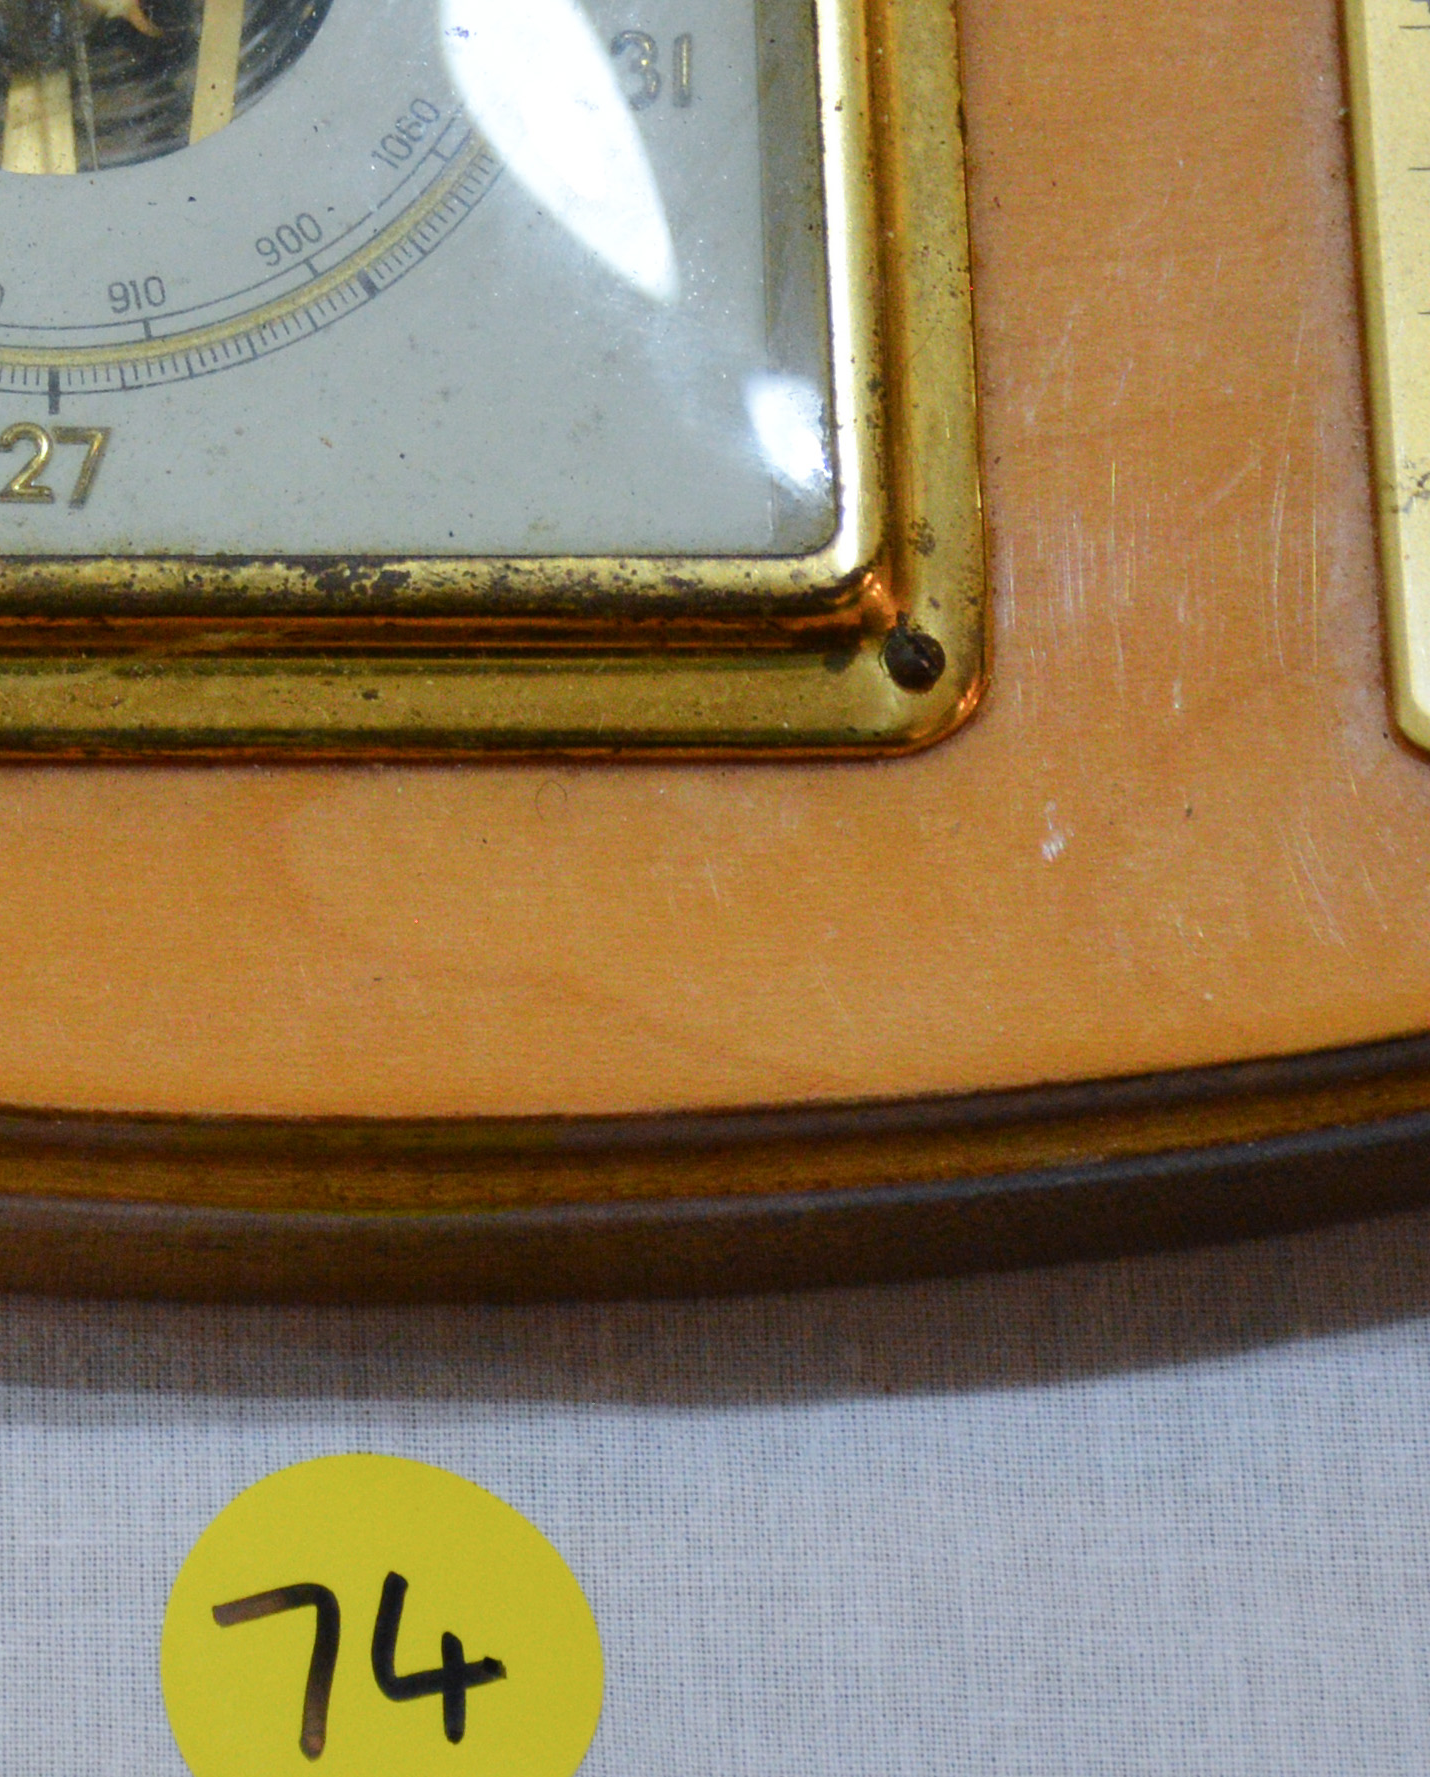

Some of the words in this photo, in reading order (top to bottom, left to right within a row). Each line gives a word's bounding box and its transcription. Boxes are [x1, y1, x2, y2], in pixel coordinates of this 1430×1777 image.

[609, 30, 693, 111] 31
[255, 211, 324, 271] 900
[108, 274, 168, 315] 910
[212, 1571, 508, 1761] 74
